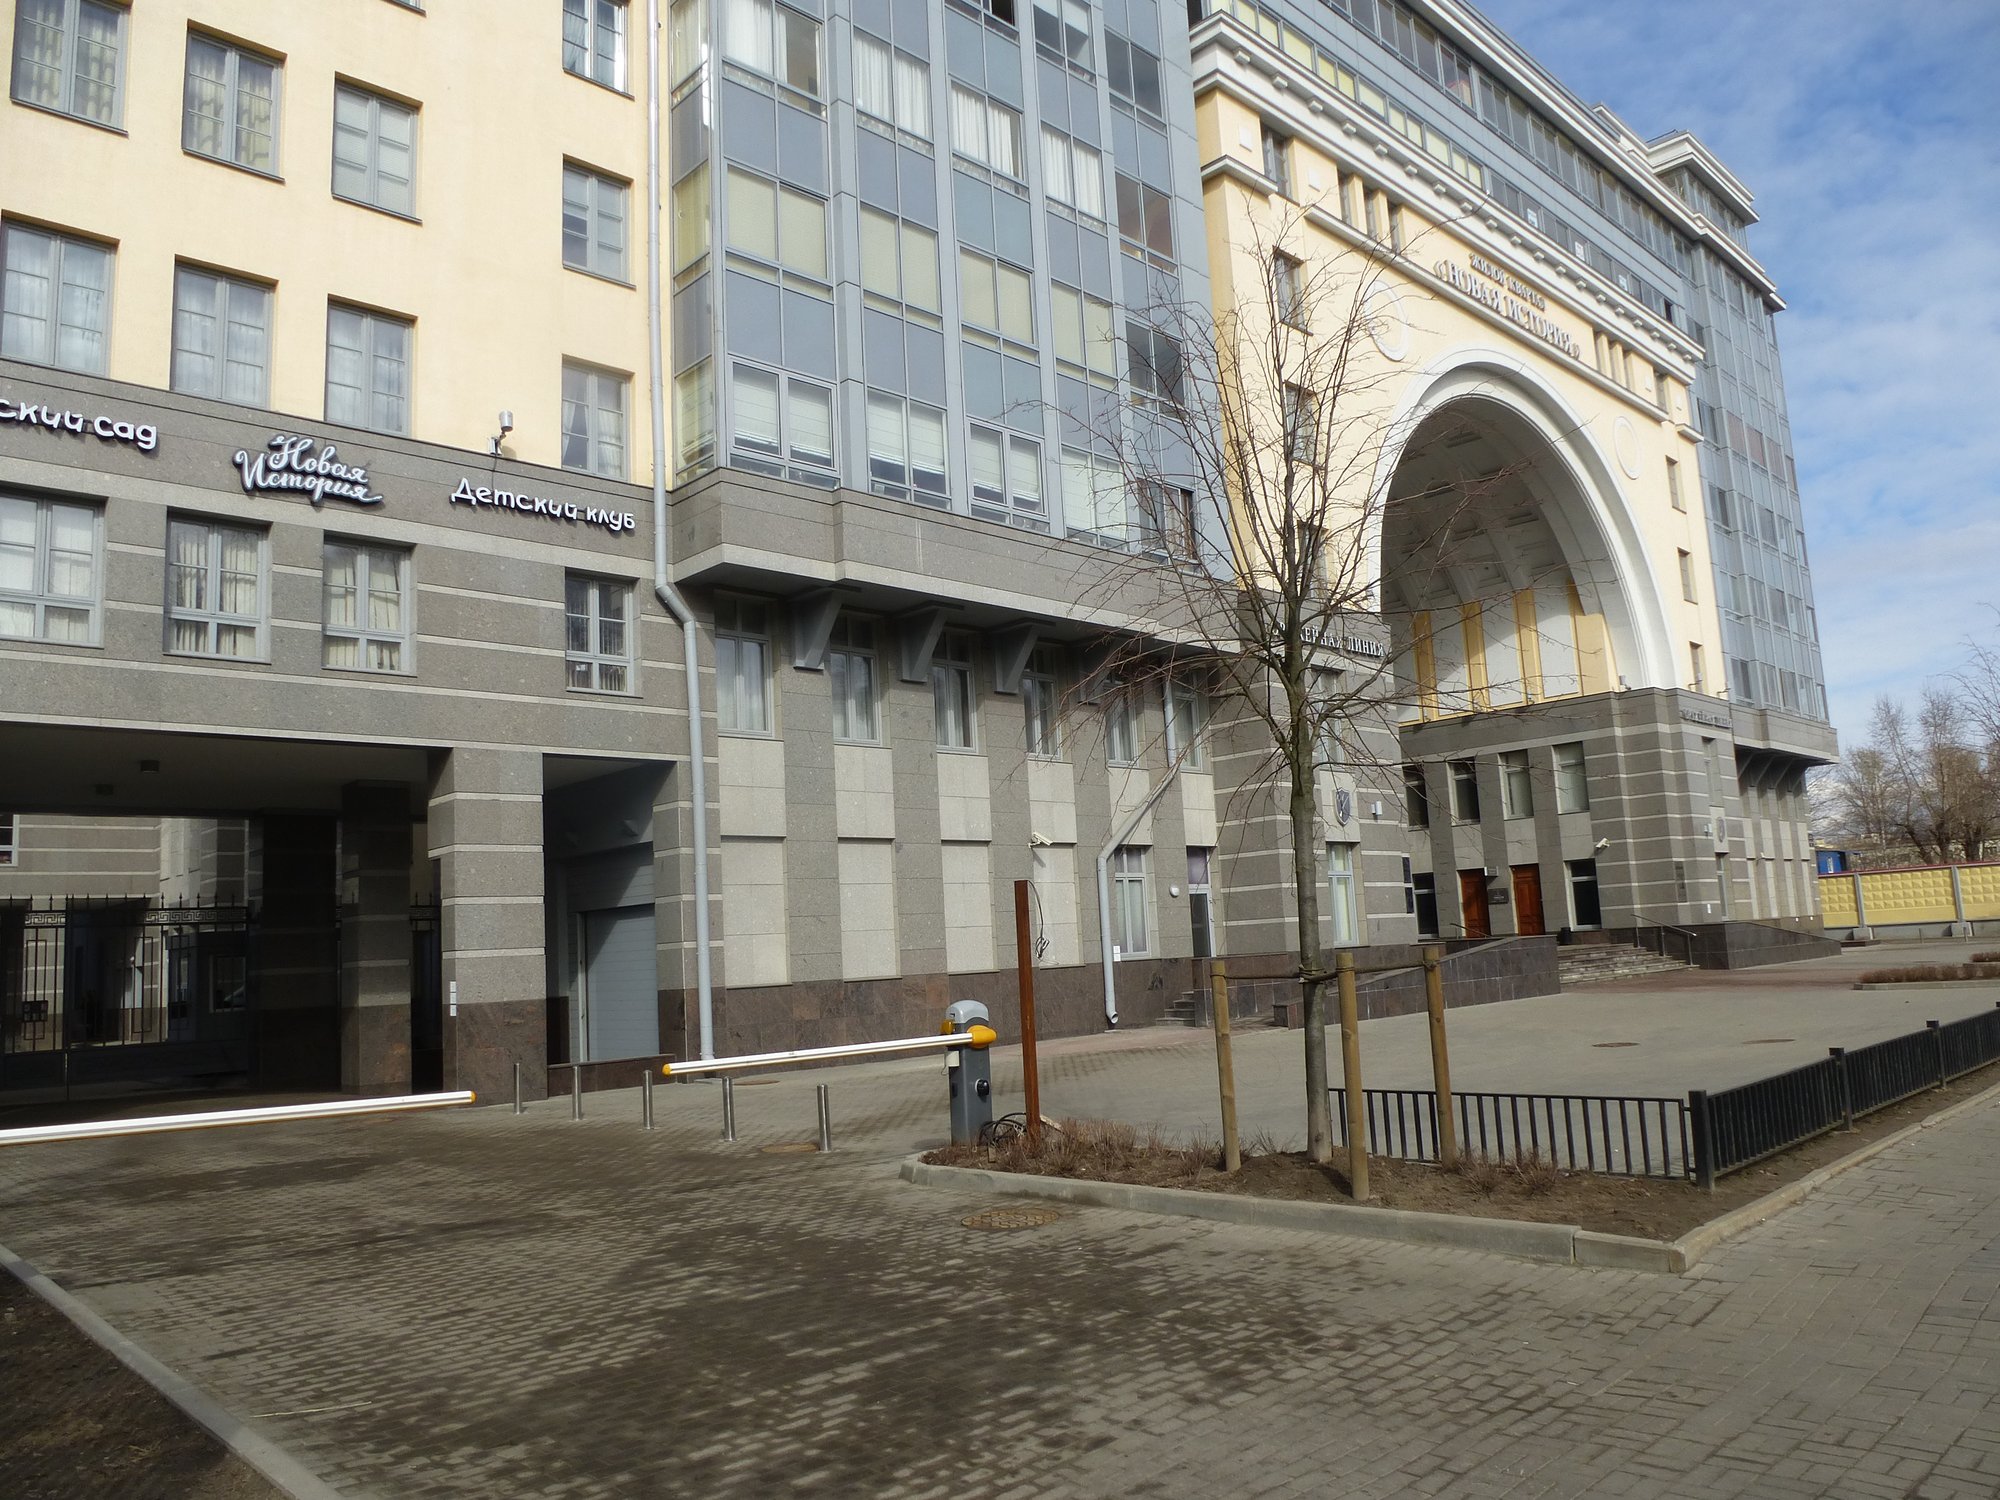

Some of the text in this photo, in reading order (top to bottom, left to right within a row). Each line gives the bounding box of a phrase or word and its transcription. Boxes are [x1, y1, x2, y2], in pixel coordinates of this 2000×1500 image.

[1433, 259, 1501, 314] «НОВАЯ
[94, 416, 157, 450] сад
[235, 450, 383, 502] История
[267, 435, 368, 483] Новая
[451, 477, 636, 531] Детский клуб
[1347, 636, 1385, 656] ЛИНИЯ
